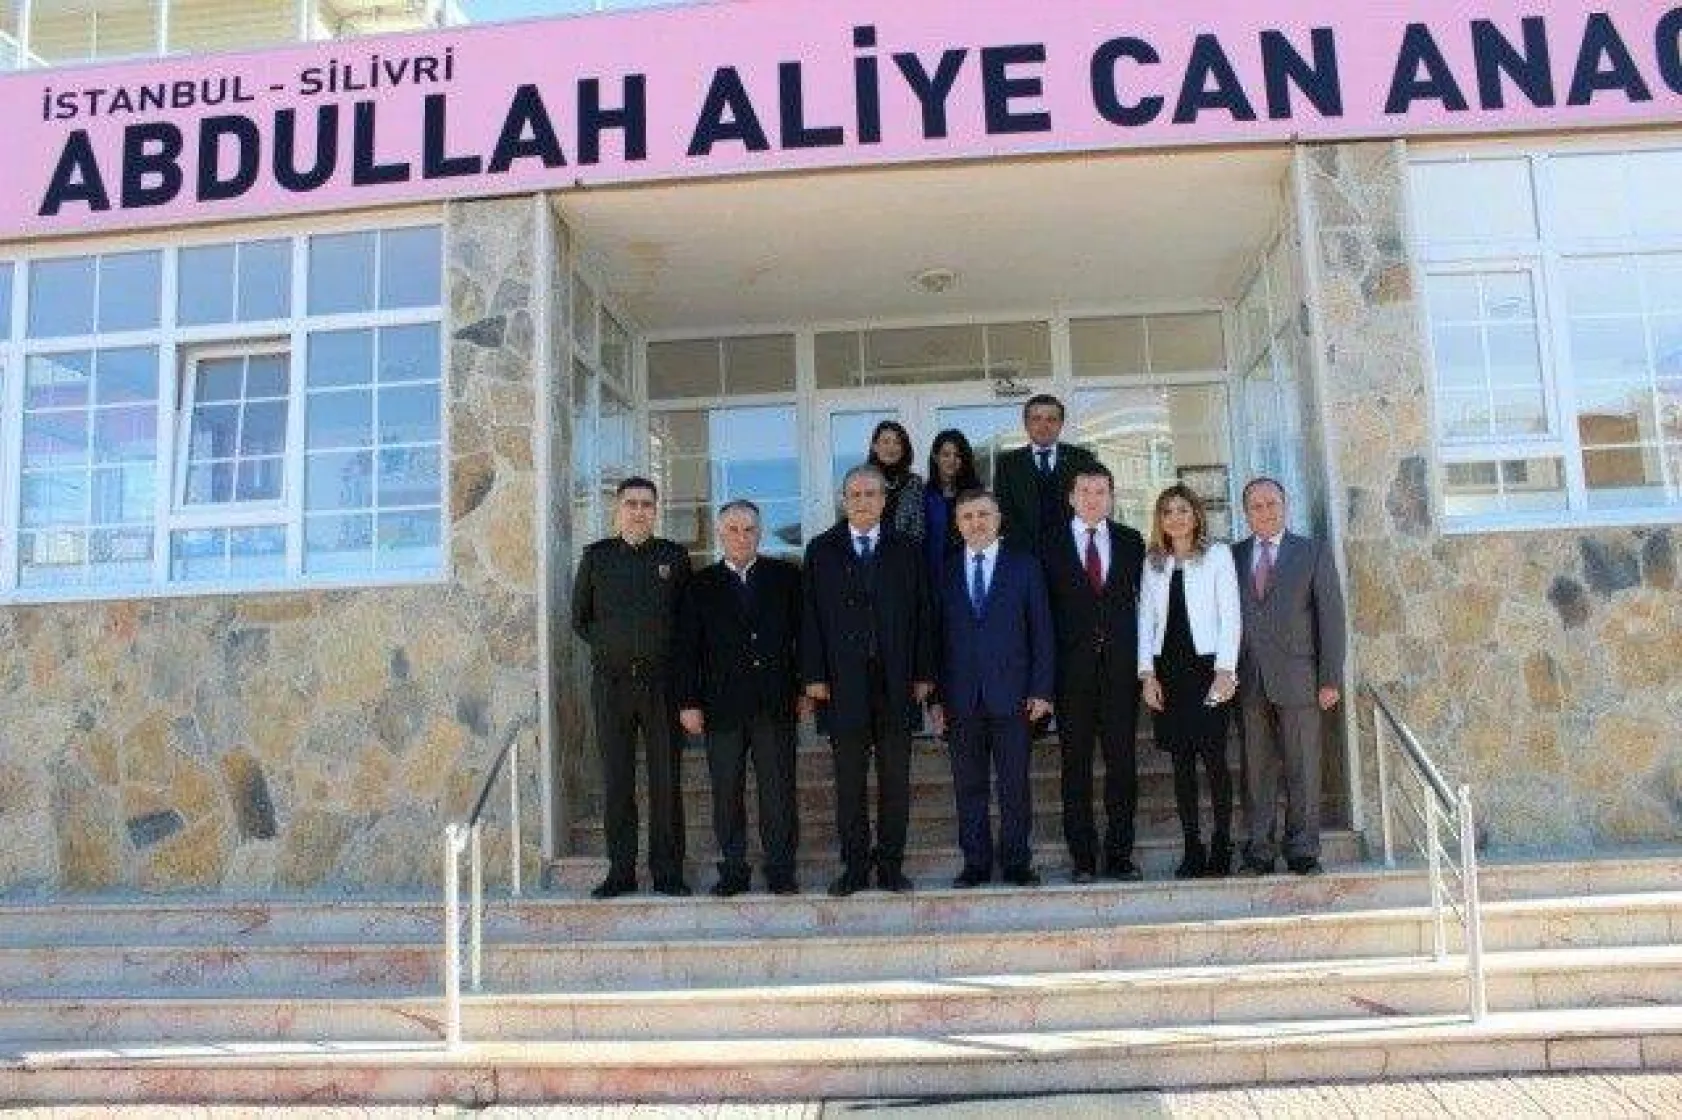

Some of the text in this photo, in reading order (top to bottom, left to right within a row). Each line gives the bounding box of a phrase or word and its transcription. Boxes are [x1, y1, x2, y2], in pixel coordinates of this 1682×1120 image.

[37, 73, 647, 217] ABDULLAH
[686, 25, 1052, 157] ALİYE
[1089, 28, 1344, 127] CAN
[42, 75, 255, 122] İSTANBUL
[300, 46, 454, 96] SİLİVRİ
